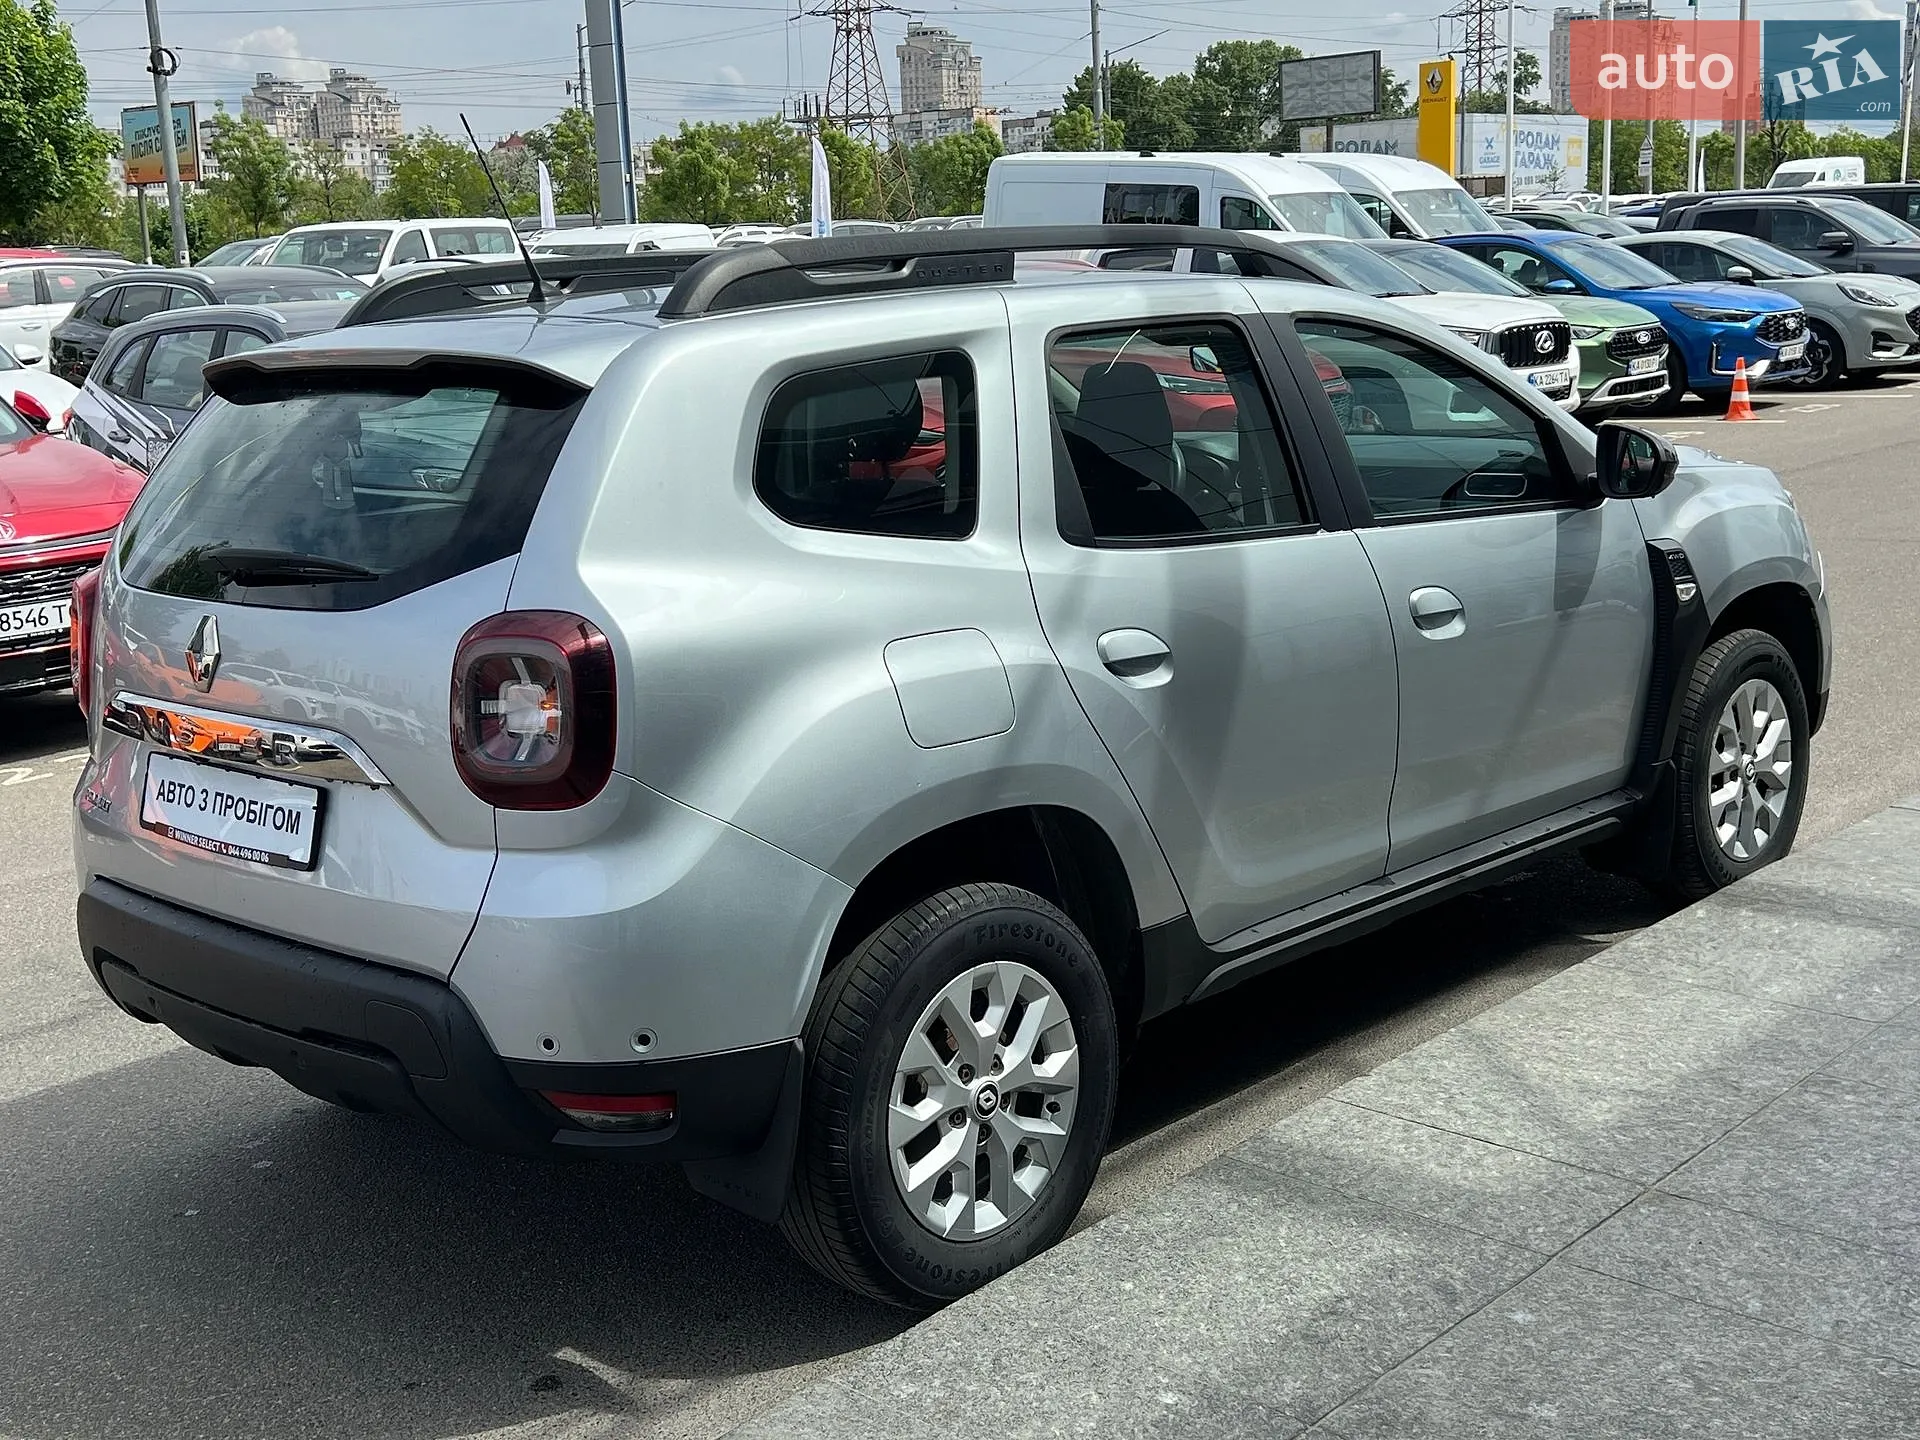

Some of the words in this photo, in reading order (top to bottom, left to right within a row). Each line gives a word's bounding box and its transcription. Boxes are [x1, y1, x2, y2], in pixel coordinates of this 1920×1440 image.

[130, 138, 154, 161] ПІСЛЯ
[915, 263, 1005, 279] DUSTER
[0, 607, 49, 632] 8546
[156, 779, 196, 808] АВТО
[212, 791, 301, 835] ПРОБІГОМ
[174, 828, 198, 844] WINNER
[198, 838, 220, 852] SELECT
[228, 845, 240, 856] 044
[240, 848, 252, 859] 496
[261, 853, 269, 863] 06
[973, 922, 1078, 968] Firestone
